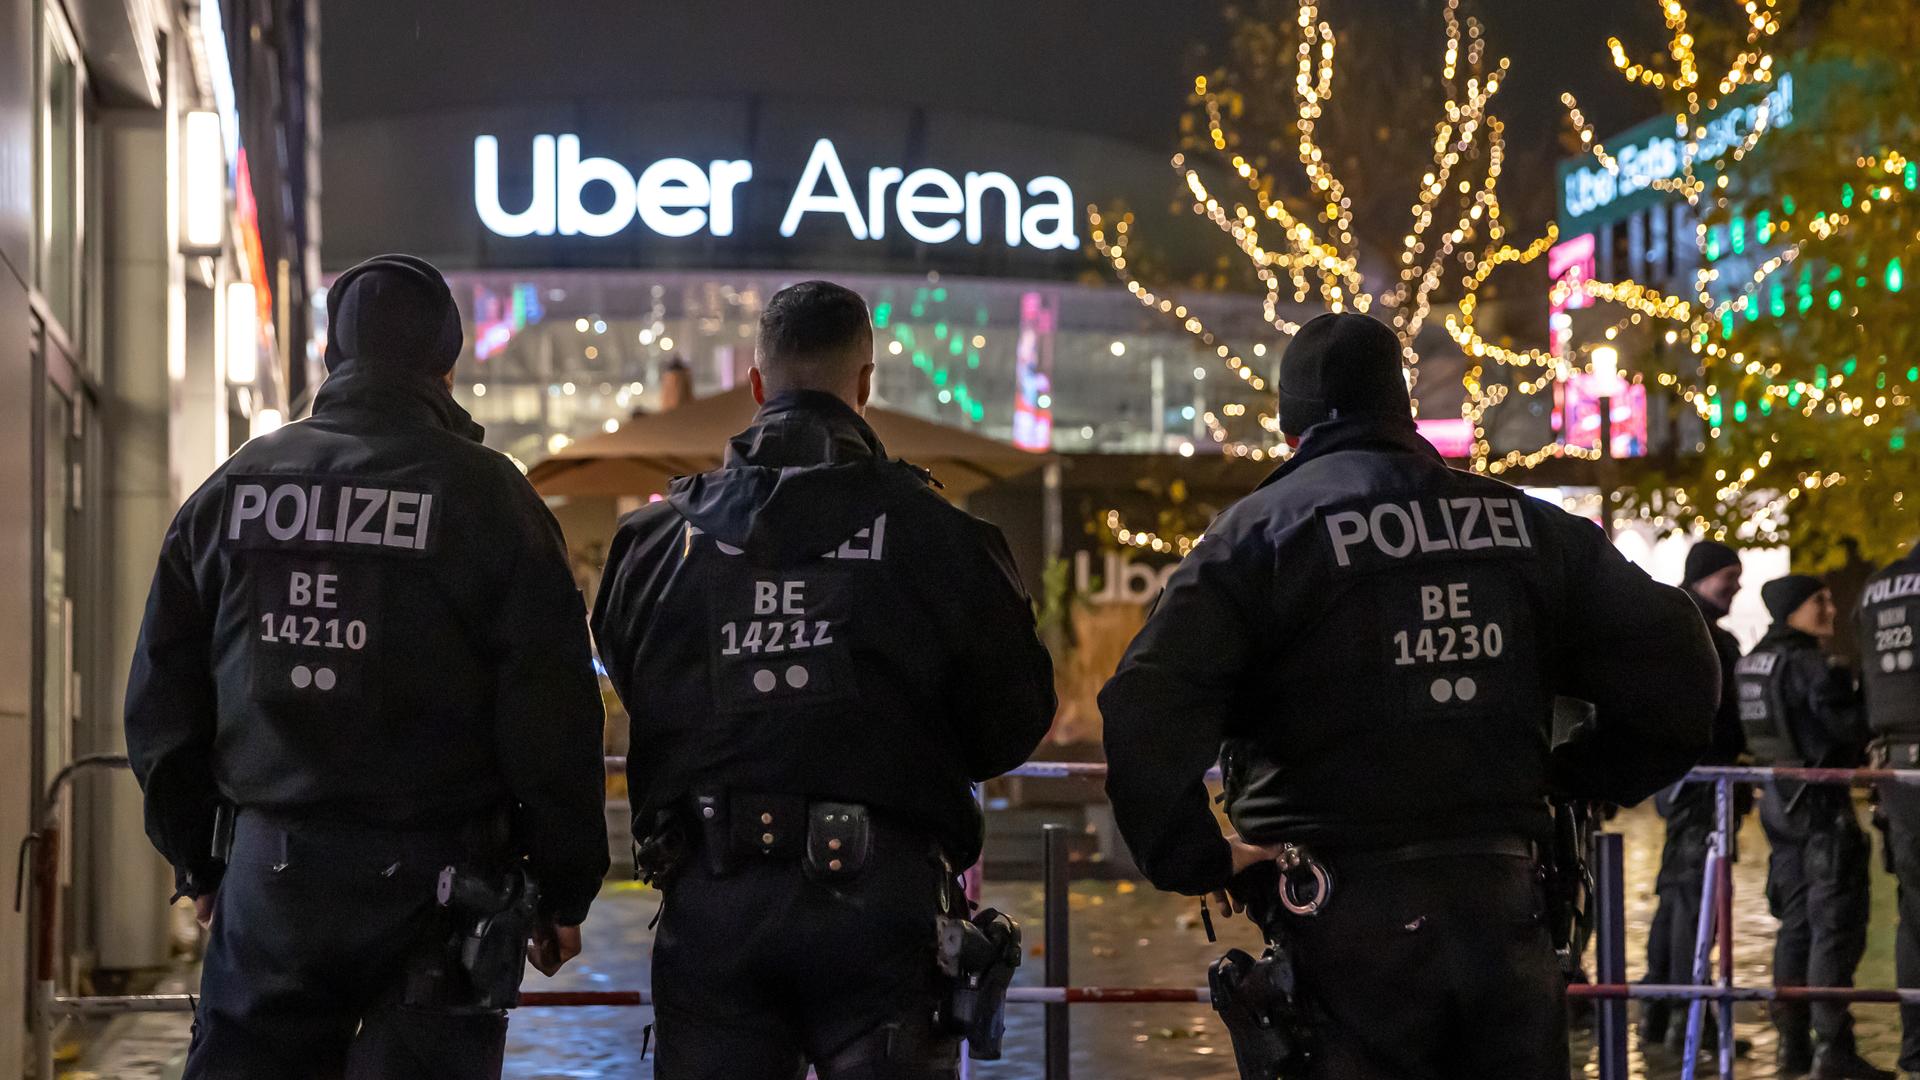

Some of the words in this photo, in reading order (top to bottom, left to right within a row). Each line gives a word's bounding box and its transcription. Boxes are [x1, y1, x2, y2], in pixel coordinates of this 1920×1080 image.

[474, 133, 753, 238] Uber
[779, 138, 1080, 251] Arena
[228, 483, 433, 550] POLIZEI
[1325, 497, 1532, 567] POLIZEI
[289, 571, 338, 609] BE
[754, 581, 805, 615] BE
[1421, 583, 1471, 621] BE
[261, 612, 367, 650] 14210
[721, 620, 833, 656] 14212
[1394, 622, 1503, 666] 14230
